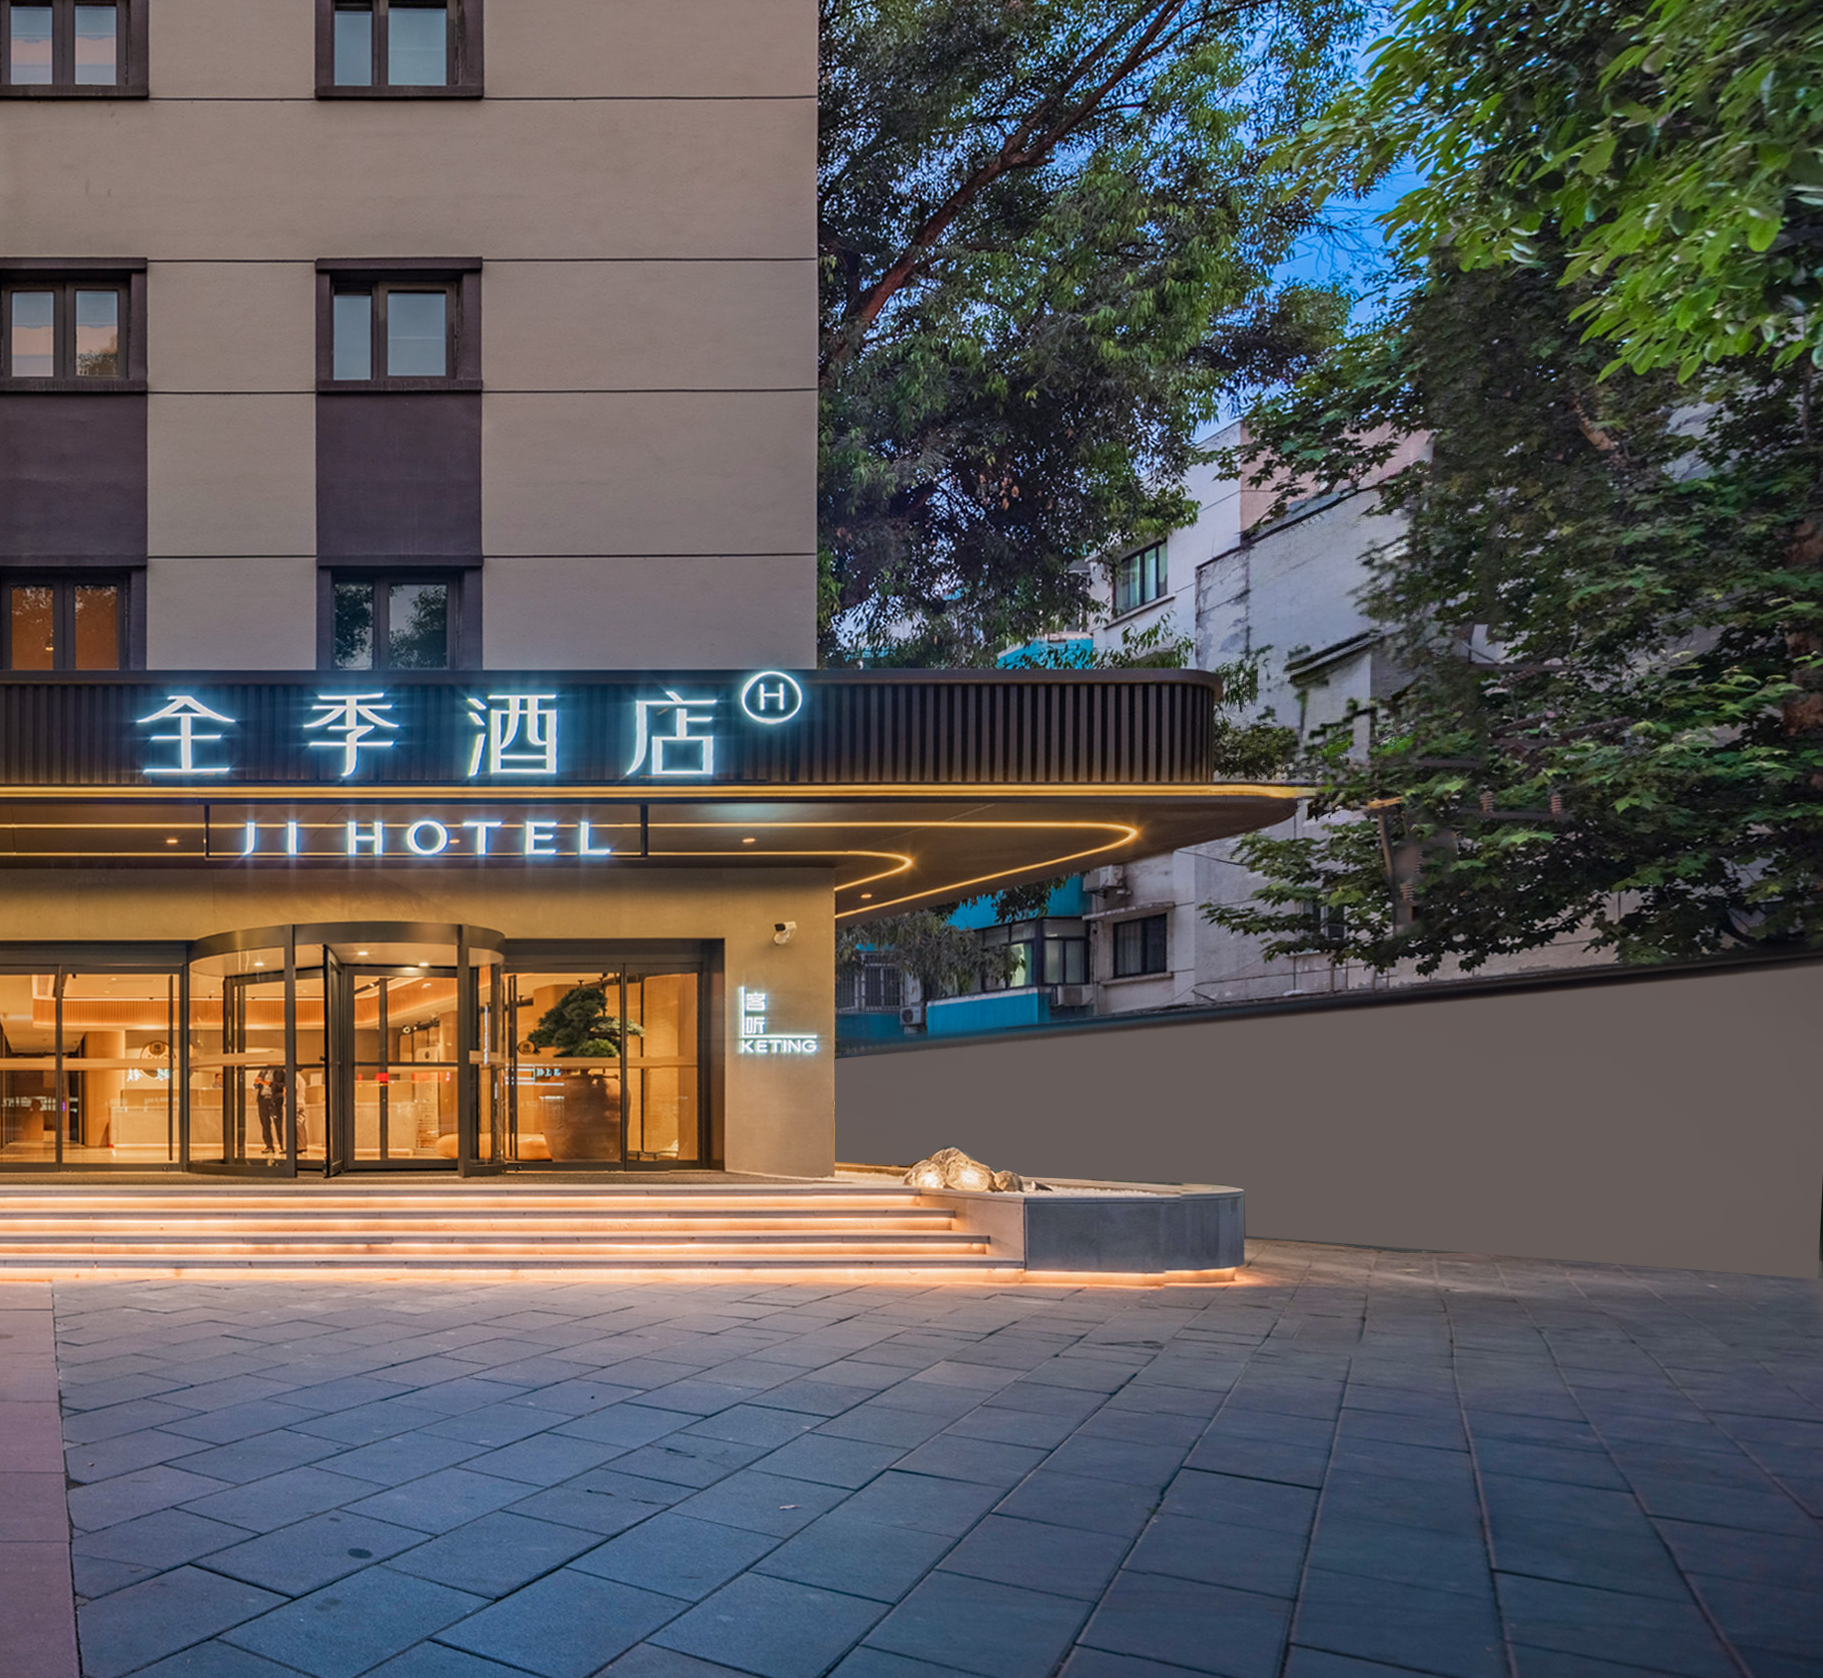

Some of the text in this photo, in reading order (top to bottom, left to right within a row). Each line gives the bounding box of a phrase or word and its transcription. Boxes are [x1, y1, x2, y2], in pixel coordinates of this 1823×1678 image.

[137, 691, 719, 777] 全季酒店
[242, 820, 611, 856] JI HOTEL
[739, 1039, 818, 1054] KETING
